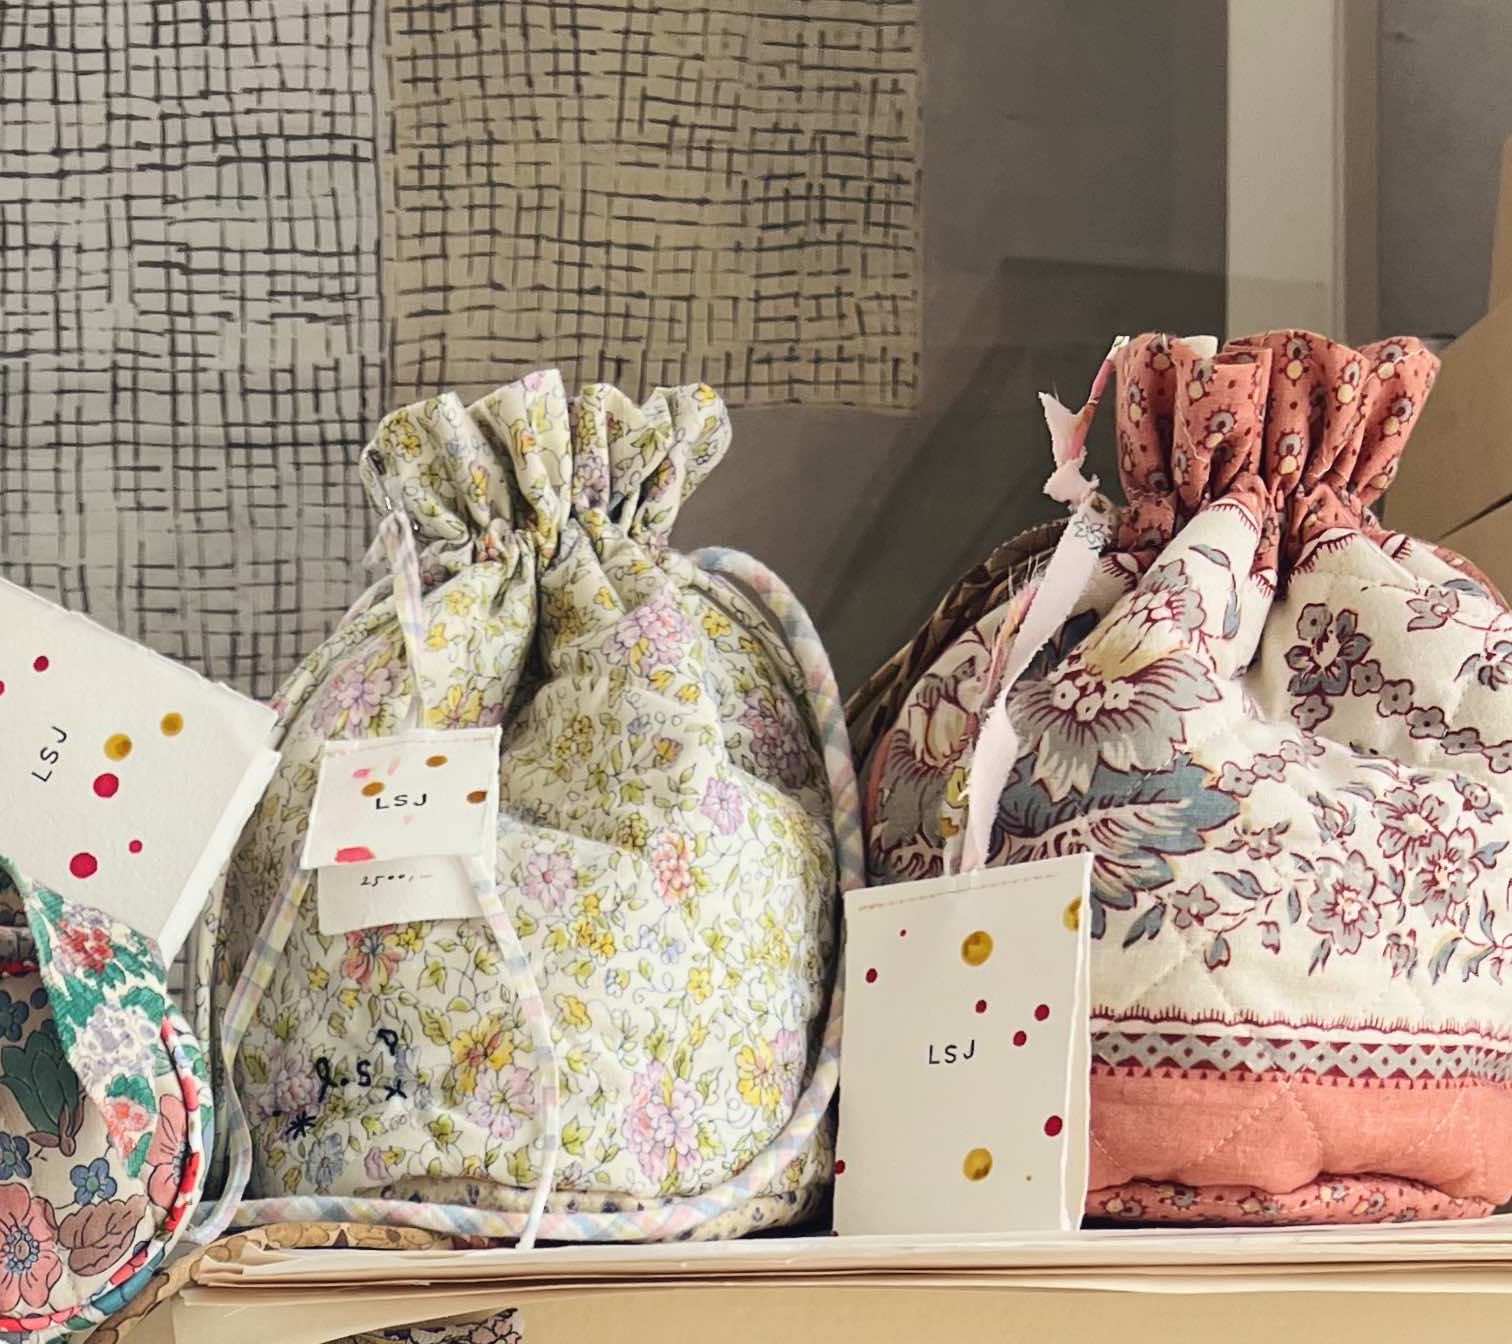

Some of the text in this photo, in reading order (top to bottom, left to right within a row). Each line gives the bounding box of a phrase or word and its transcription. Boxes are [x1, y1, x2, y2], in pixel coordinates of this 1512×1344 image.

[32, 726, 67, 783] LSJ
[375, 793, 428, 810] LSJ
[928, 1039, 976, 1065] LSJ
